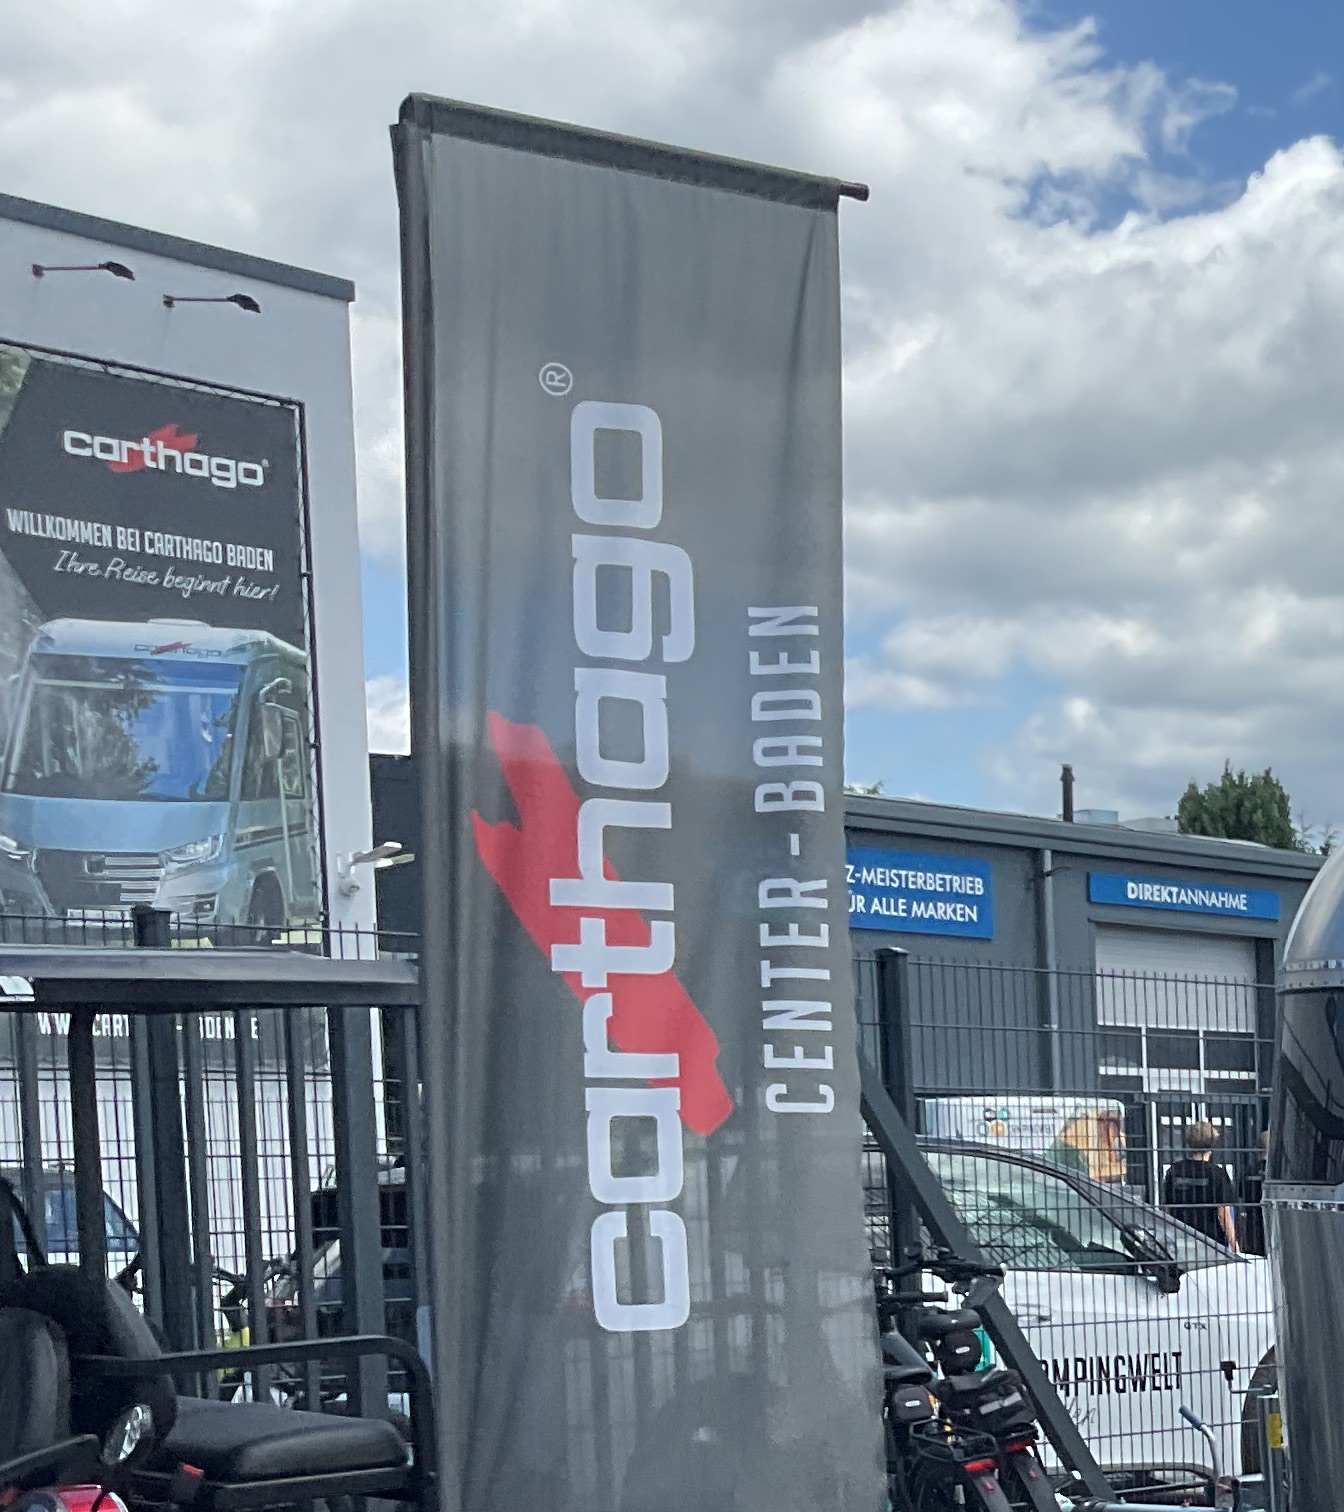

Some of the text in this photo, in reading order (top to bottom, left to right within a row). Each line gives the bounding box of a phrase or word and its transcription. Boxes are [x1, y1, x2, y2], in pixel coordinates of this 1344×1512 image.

[64, 430, 265, 489] carthago
[6, 508, 274, 572] WILLKOMMEN BEI CARTHAGO BADEN
[53, 550, 281, 600] Ihre Reise beginnt hier!
[549, 400, 696, 1331] carthago
[845, 864, 984, 896] Z-MEISTERBETRIEB
[870, 897, 907, 917] ALLE
[911, 901, 978, 923] MARKEN
[1126, 881, 1247, 911] DIREKTANNAHME
[1039, 1350, 1182, 1397] MPINGWELT
